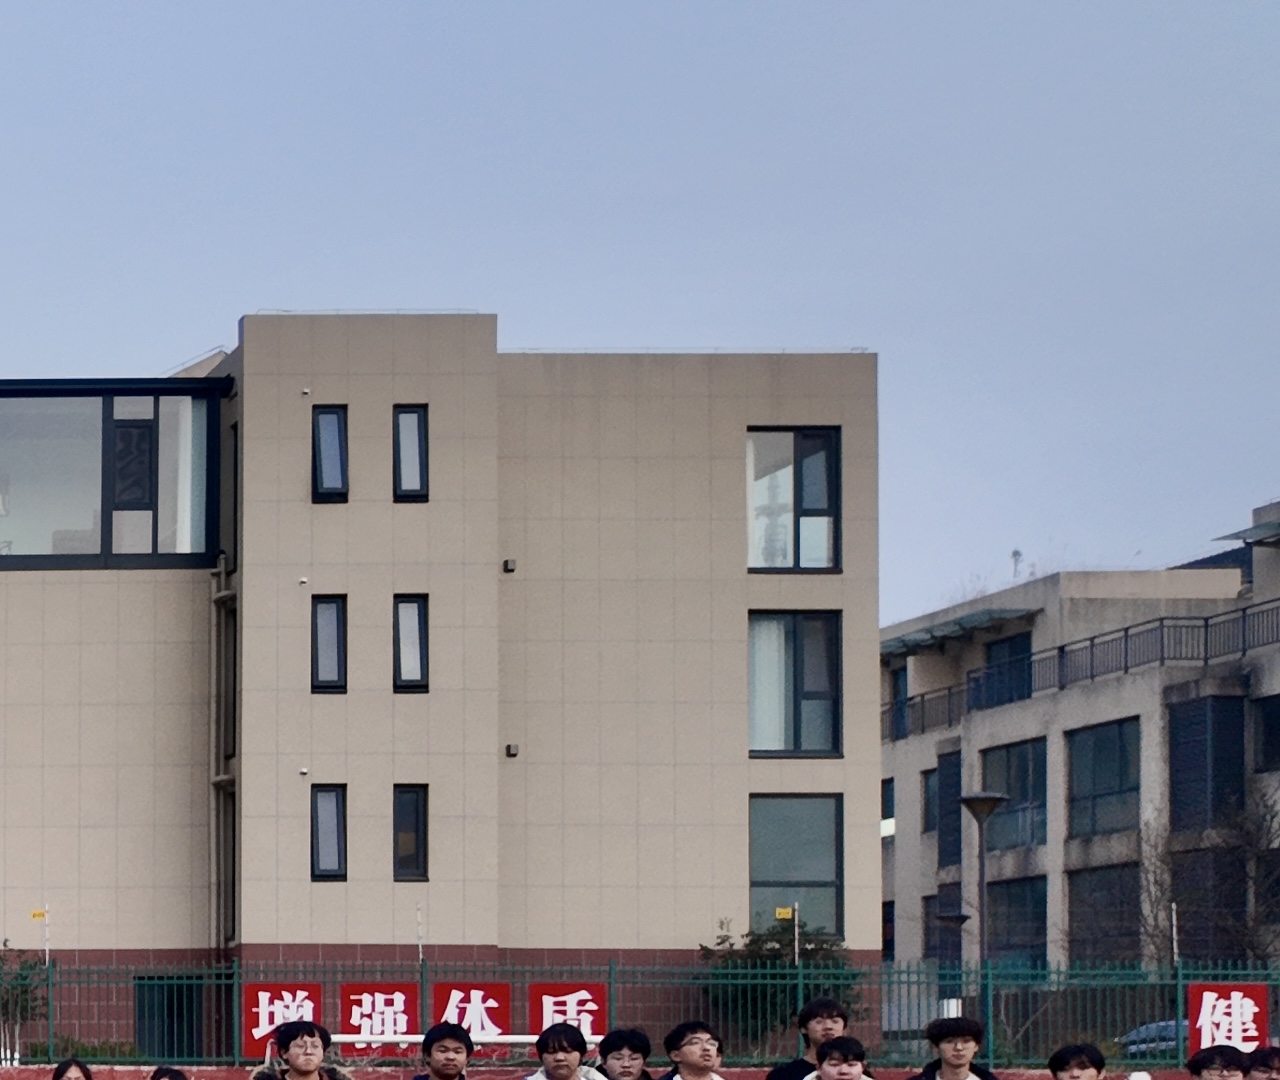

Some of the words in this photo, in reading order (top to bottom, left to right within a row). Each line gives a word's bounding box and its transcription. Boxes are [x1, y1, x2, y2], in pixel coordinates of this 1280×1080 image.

[251, 989, 599, 1048] 增强体质
[1196, 991, 1260, 1053] 健
